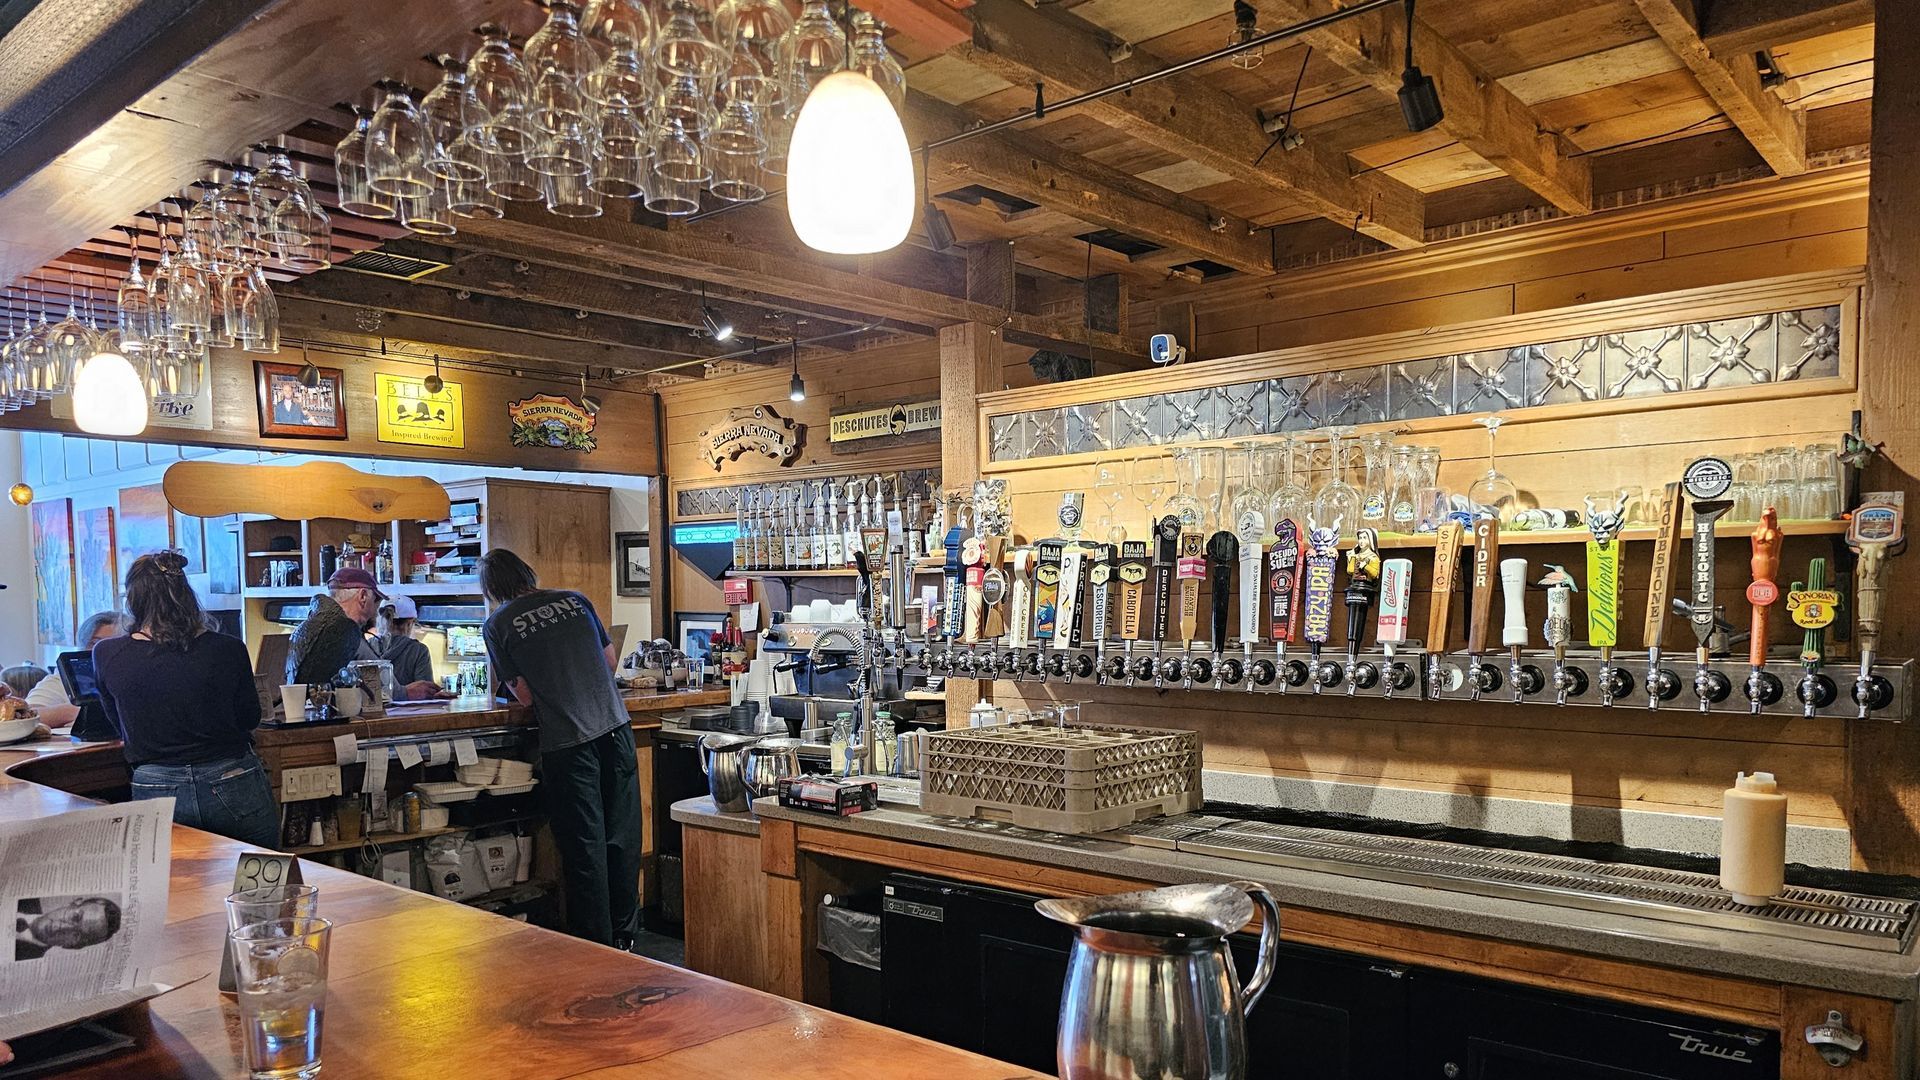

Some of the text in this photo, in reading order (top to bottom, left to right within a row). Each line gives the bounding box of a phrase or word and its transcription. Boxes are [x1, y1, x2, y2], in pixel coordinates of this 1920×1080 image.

[522, 406, 583, 423] SIERRA NEVADA
[833, 414, 888, 435] DESCHUTES
[392, 429, 452, 443] Inspired Brewing
[712, 424, 781, 449] SIERRA NEVADA
[1042, 546, 1060, 557] BAJA
[1096, 547, 1109, 557] BAJA
[1124, 543, 1145, 554] BAJA
[1270, 547, 1298, 561] PSEUDO
[1270, 558, 1288, 570] SUE
[1436, 530, 1449, 586] STOIC
[1476, 524, 1489, 588] CIDER
[1650, 501, 1673, 618] TOMBSTONE
[1697, 523, 1709, 603] HISTORIC
[1071, 561, 1087, 642] PRAIRIE
[1126, 589, 1137, 635] CABOTELLA
[1159, 569, 1168, 638] DESCHUTES
[1308, 566, 1330, 637] HAZY IPA
[1589, 552, 1616, 641] Delicious
[1787, 591, 1836, 609] SONORAN
[512, 596, 583, 633] STONE
[520, 608, 586, 639] BREWING
[1094, 588, 1104, 638] ESCORPION
[129, 843, 141, 874] Honors
[128, 875, 139, 891] the
[240, 857, 282, 899] 39
